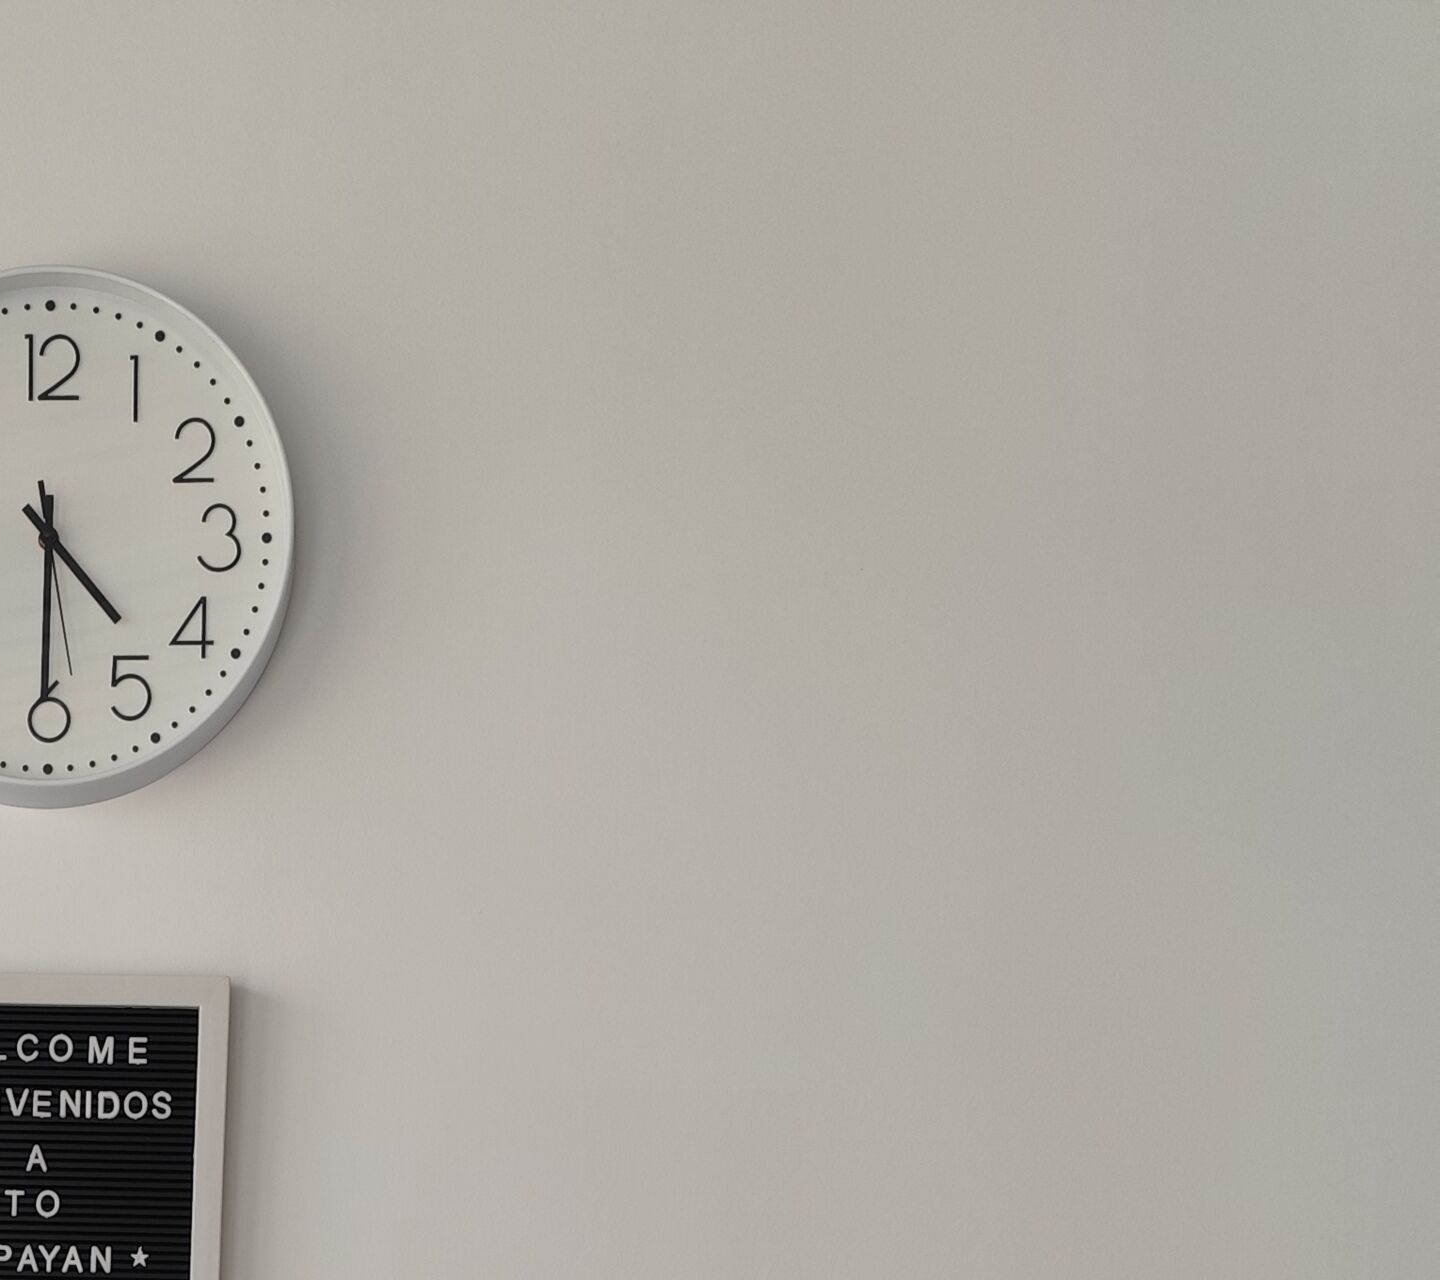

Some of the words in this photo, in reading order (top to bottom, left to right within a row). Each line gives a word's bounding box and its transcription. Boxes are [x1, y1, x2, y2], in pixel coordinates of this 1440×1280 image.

[24, 333, 80, 401] 12
[129, 354, 139, 423] 1
[172, 417, 216, 484] 2
[196, 503, 242, 572] 3
[168, 596, 215, 659] 4
[27, 679, 72, 743] 6
[110, 655, 153, 721] 5
[25, 1143, 49, 1174] A
[4, 1189, 61, 1219] TO
